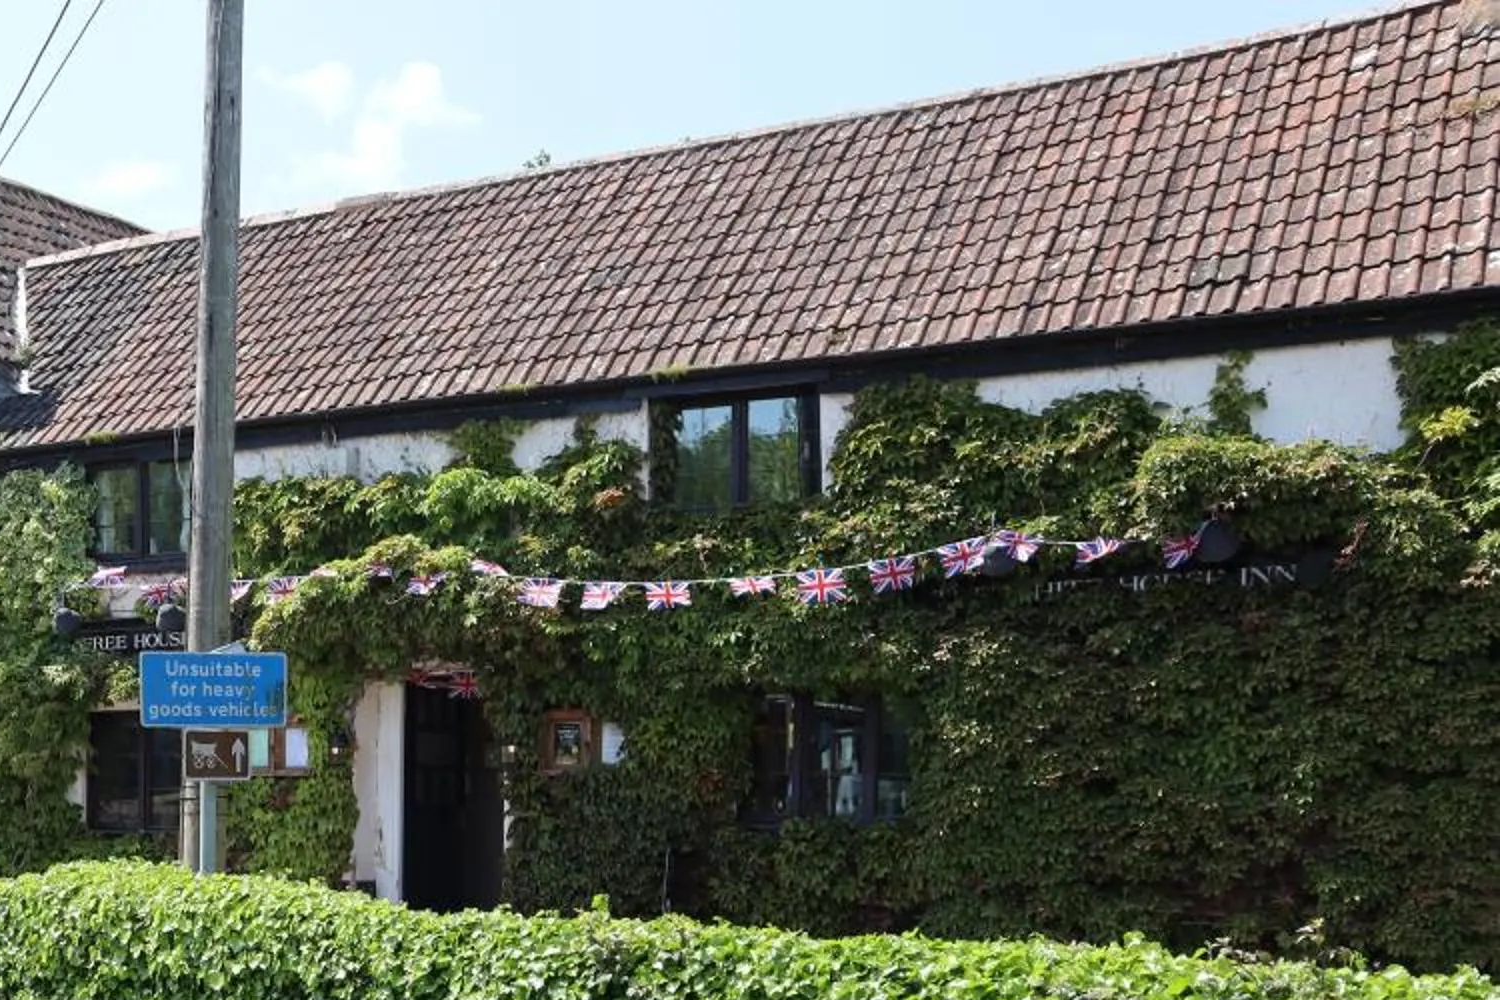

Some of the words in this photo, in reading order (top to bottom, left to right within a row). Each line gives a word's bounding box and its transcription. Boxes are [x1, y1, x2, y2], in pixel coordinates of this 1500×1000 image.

[1239, 563, 1299, 589] INN
[165, 659, 261, 677] Unsuitable
[171, 681, 196, 697] for
[202, 681, 255, 701] heavy
[149, 702, 202, 720] goods
[209, 702, 277, 717] vehicles
